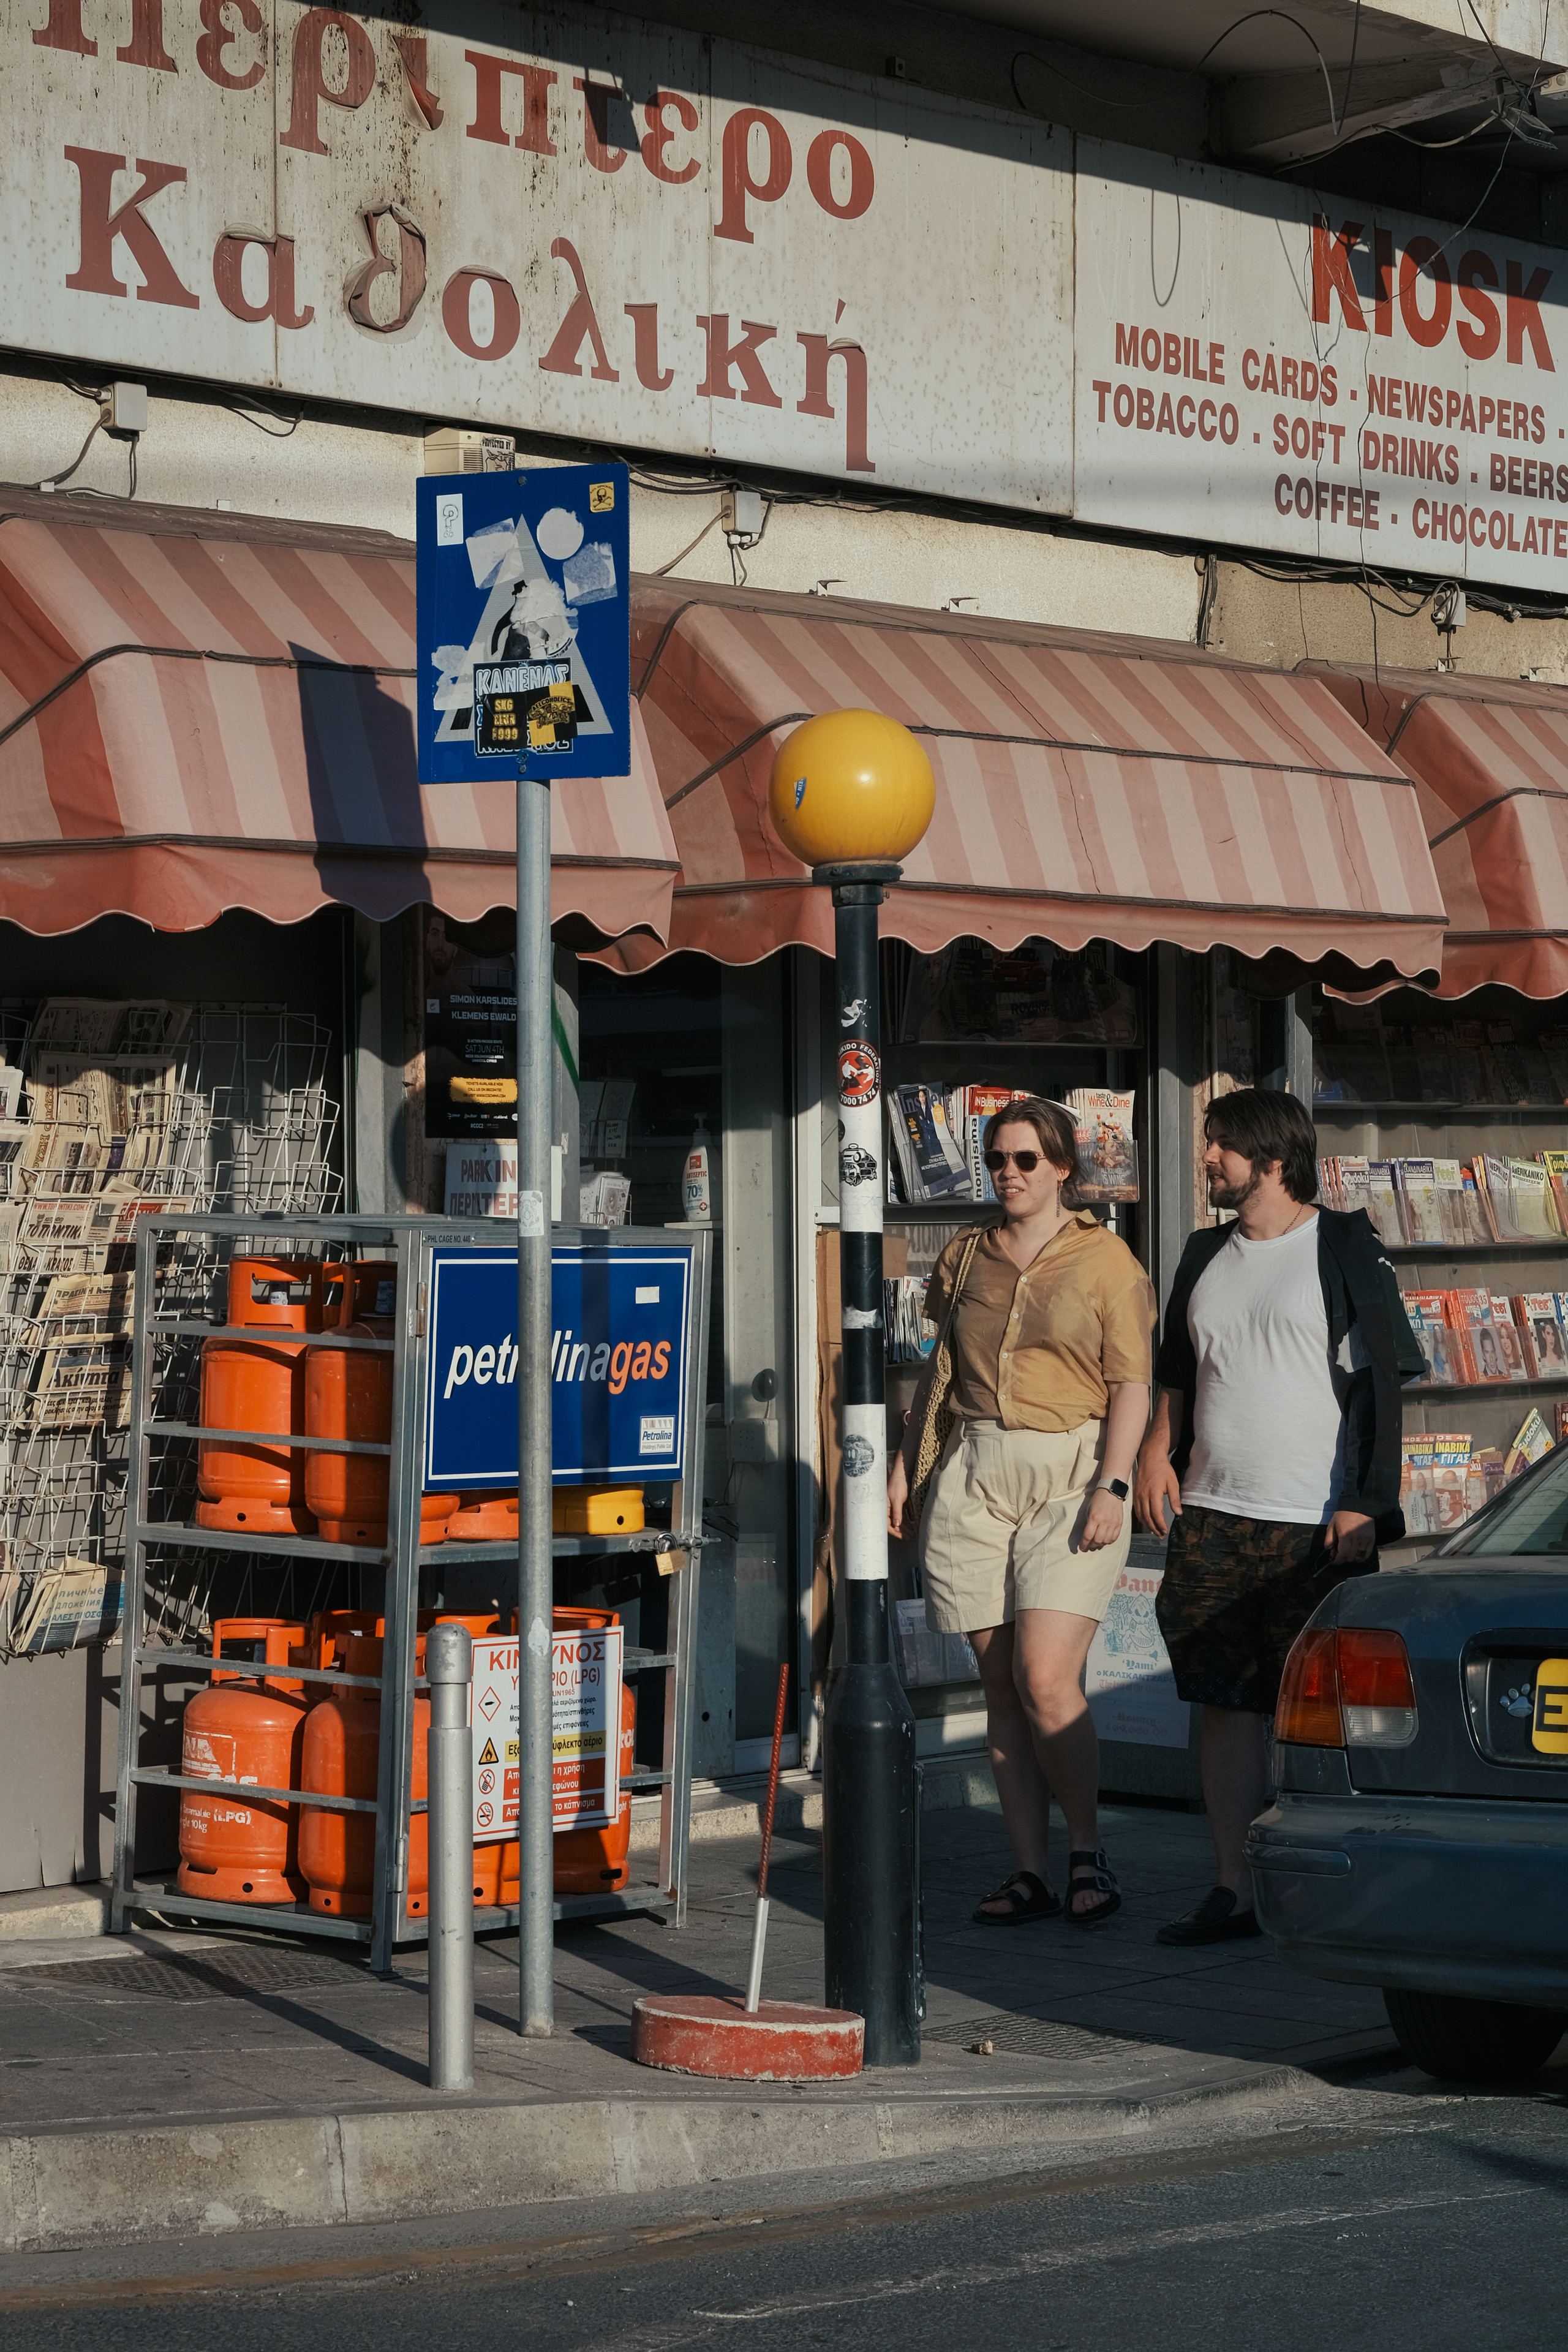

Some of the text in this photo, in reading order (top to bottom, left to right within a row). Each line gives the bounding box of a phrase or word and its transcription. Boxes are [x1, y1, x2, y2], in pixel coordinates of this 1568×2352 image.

[1311, 212, 1556, 373] KIOSK
[1115, 322, 1546, 445] MOBILE CARDS NEWSPAPERS
[482, 439, 511, 450] PROTECTED BY
[1091, 379, 1568, 504] TOBACCO SOFT DRINKS BEERS
[1275, 473, 1380, 531] COFFEE
[450, 994, 518, 1005] SIMON KARSLIDES
[451, 1011, 516, 1021] KLEMENS EWALD
[466, 1044, 477, 1053] SAT
[492, 1045, 504, 1054] 4TH
[859, 1044, 880, 1084] FEDERATION
[840, 1094, 857, 1105] 7000
[971, 1118, 981, 1198] nomisma
[461, 1159, 516, 1183] PARKIN
[687, 1170, 707, 1179] ANTISEPTIC
[1109, 1174, 1126, 1185] WINE
[1479, 1294, 1488, 1305] 35
[443, 1329, 671, 1399] petrlinagas
[47, 1366, 120, 1388] Ακίνητα
[642, 1430, 672, 1441] Petrolina
[1435, 1441, 1471, 1453] ΙΝΑΒΙΚΑ
[1441, 1453, 1471, 1464] ΓΙΓΑΣ
[571, 1667, 600, 1689] (LPG)
[562, 1720, 589, 1730] επιφάνειες
[552, 1736, 603, 1752] ύφλεκτο αέριο
[564, 1763, 585, 1776] χρήση
[552, 1780, 579, 1792] εφώνου
[564, 1799, 595, 1810] κάπνισμα
[213, 1809, 252, 1825] (LPG)
[191, 1820, 208, 1833] 10kg
